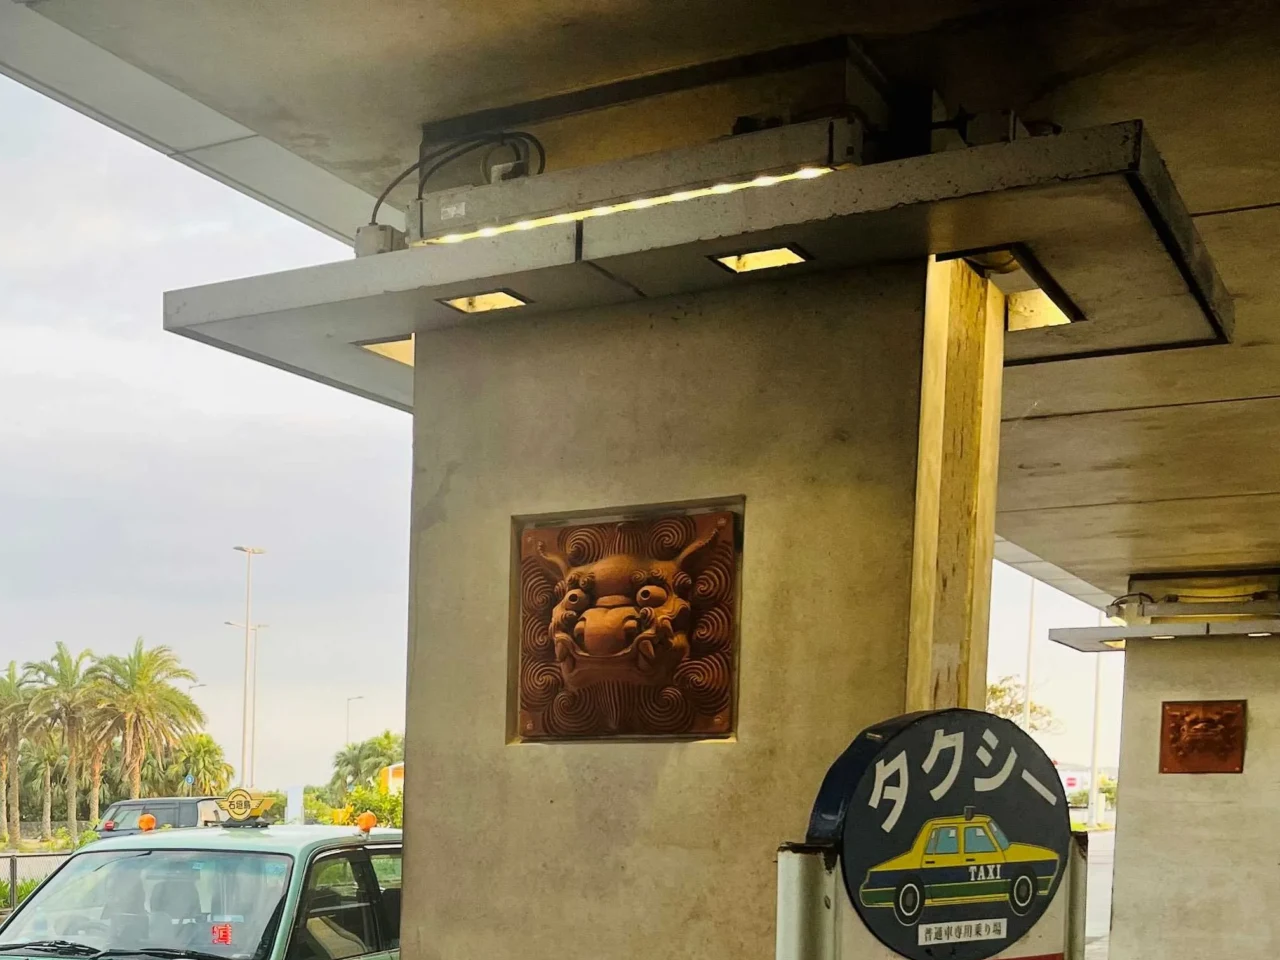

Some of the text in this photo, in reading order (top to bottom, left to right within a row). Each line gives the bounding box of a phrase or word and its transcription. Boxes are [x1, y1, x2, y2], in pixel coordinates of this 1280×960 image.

[867, 728, 1058, 834] タクシー
[968, 864, 1002, 882] TAXI
